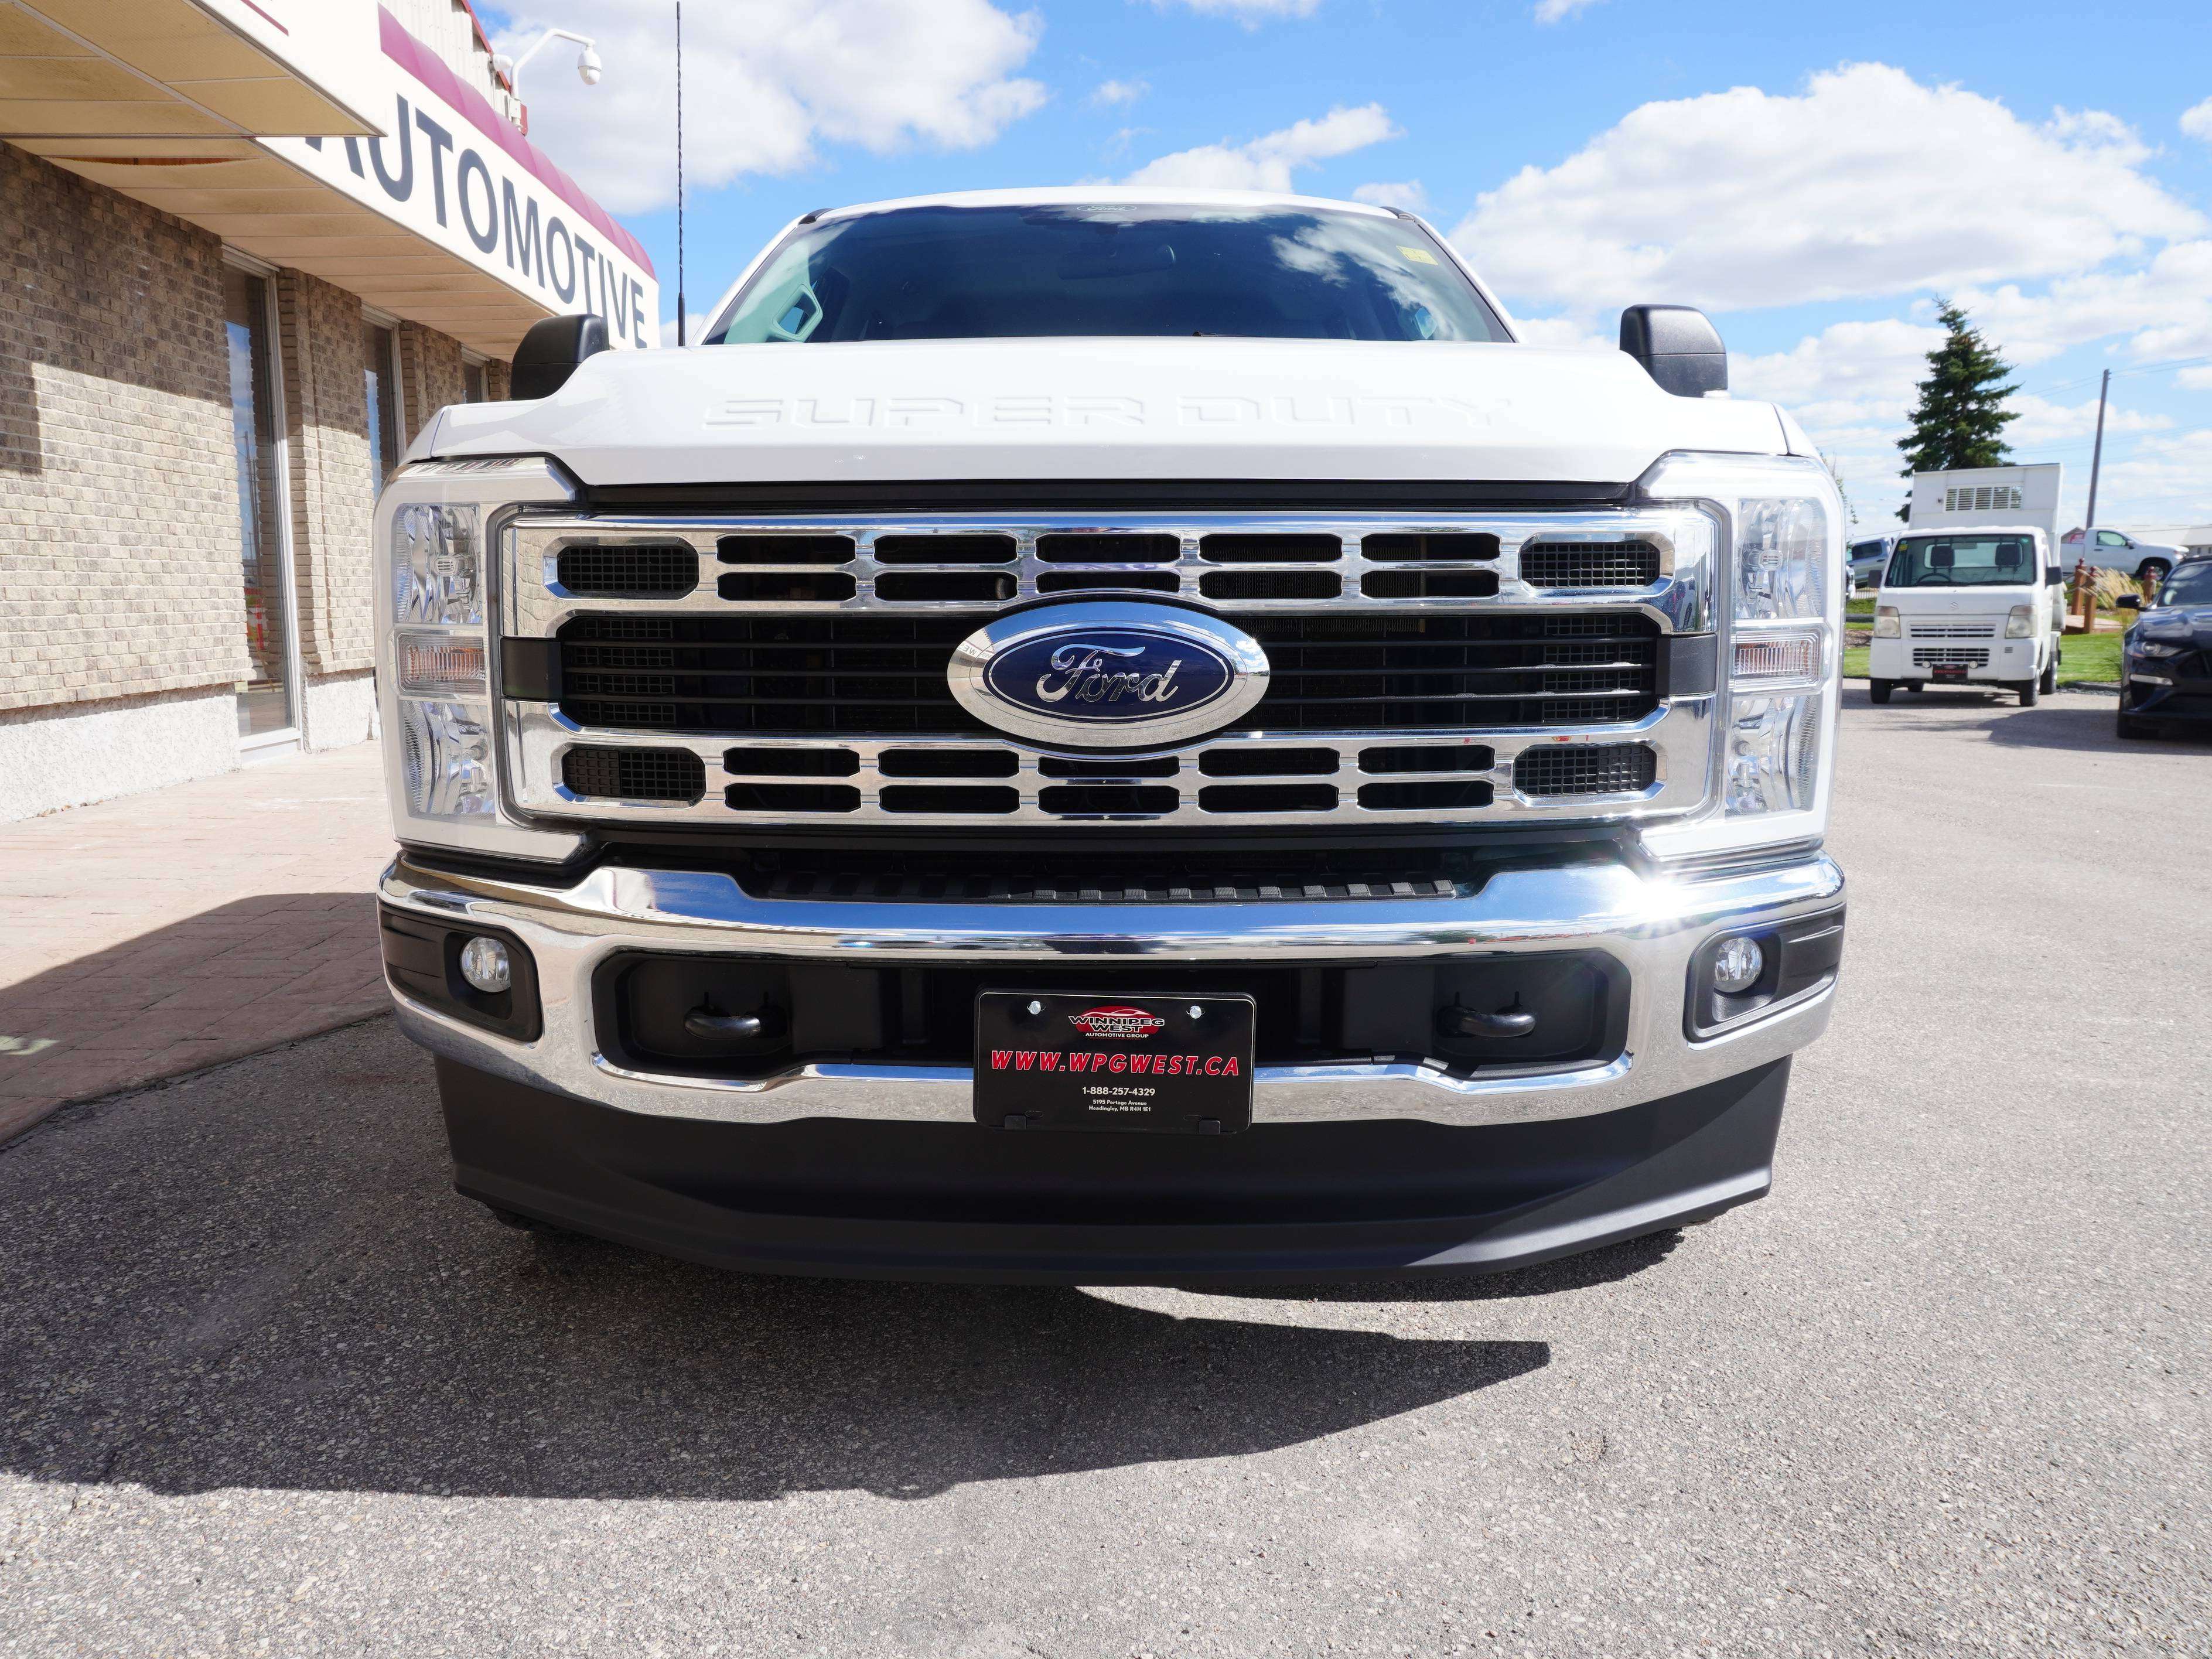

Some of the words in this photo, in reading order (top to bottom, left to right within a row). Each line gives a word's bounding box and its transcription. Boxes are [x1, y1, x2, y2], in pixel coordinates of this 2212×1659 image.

[702, 396, 1148, 430] SUPER
[1176, 395, 1512, 427] DUTY
[1036, 644, 1182, 703] Ford
[1068, 1016, 1165, 1026] WINNIPEG
[1090, 1025, 1143, 1033] WEST
[991, 1050, 1239, 1076] WWW.WPGWEST.CA
[1082, 1087, 1155, 1096] 1-888-257-4329
